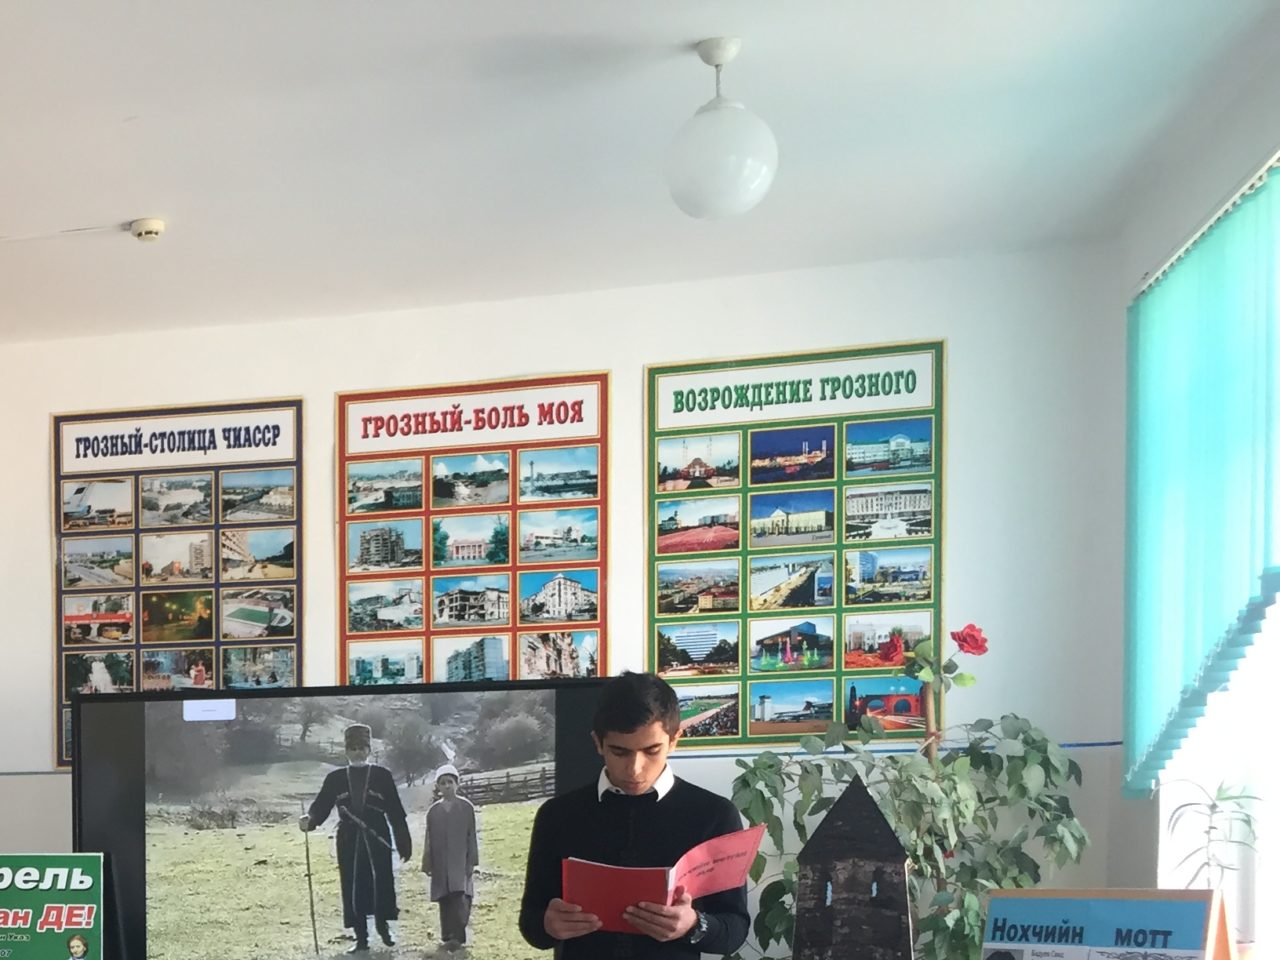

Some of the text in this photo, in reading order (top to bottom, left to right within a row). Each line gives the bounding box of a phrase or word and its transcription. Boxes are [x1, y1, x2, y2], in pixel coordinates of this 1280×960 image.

[673, 369, 917, 413] ВОЗРОЖДЕНИЕ ГРОЗНОГО
[361, 399, 584, 439] ГРОЗНЫЙ-БОЛЬ МОЯ
[75, 424, 281, 459] ГРОЗНЫЙ-СТОЛИЦА ЧИАССР
[36, 904, 96, 932] ДЕ!
[991, 917, 1084, 945] Нохчийн
